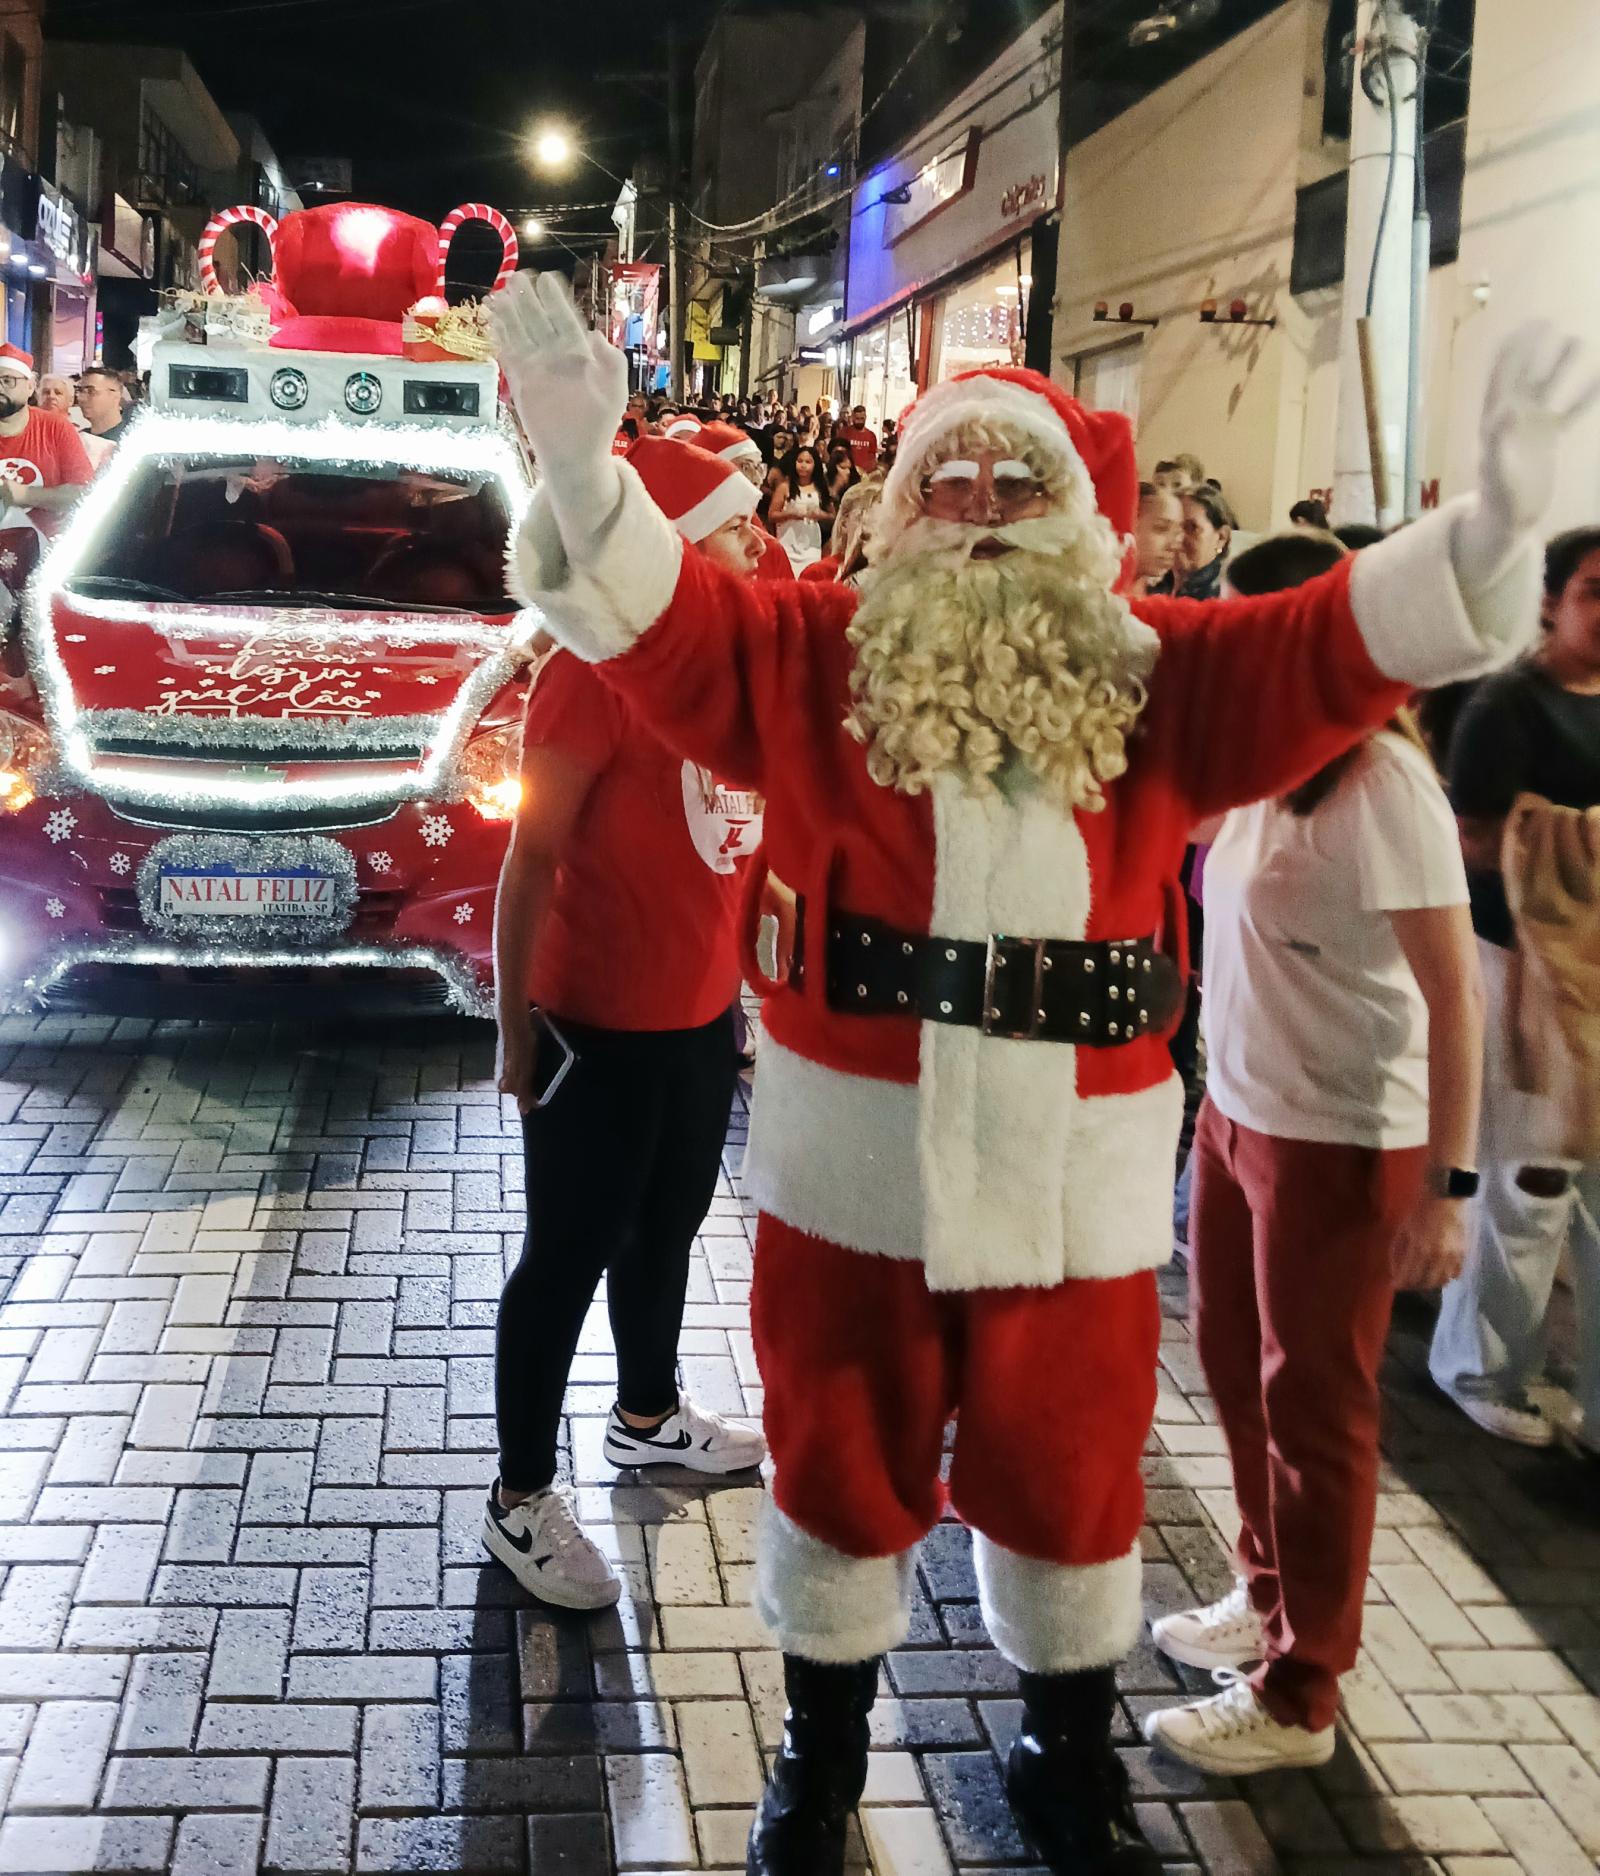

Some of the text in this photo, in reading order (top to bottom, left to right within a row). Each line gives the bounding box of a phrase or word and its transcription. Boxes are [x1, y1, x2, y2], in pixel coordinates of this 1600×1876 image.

[237, 647, 357, 664] amor
[204, 655, 362, 685] alegria
[157, 682, 371, 716] gratidão
[168, 878, 328, 902] NATAL FELIZ
[263, 903, 306, 913] ITATIBA
[315, 904, 328, 913] SP
